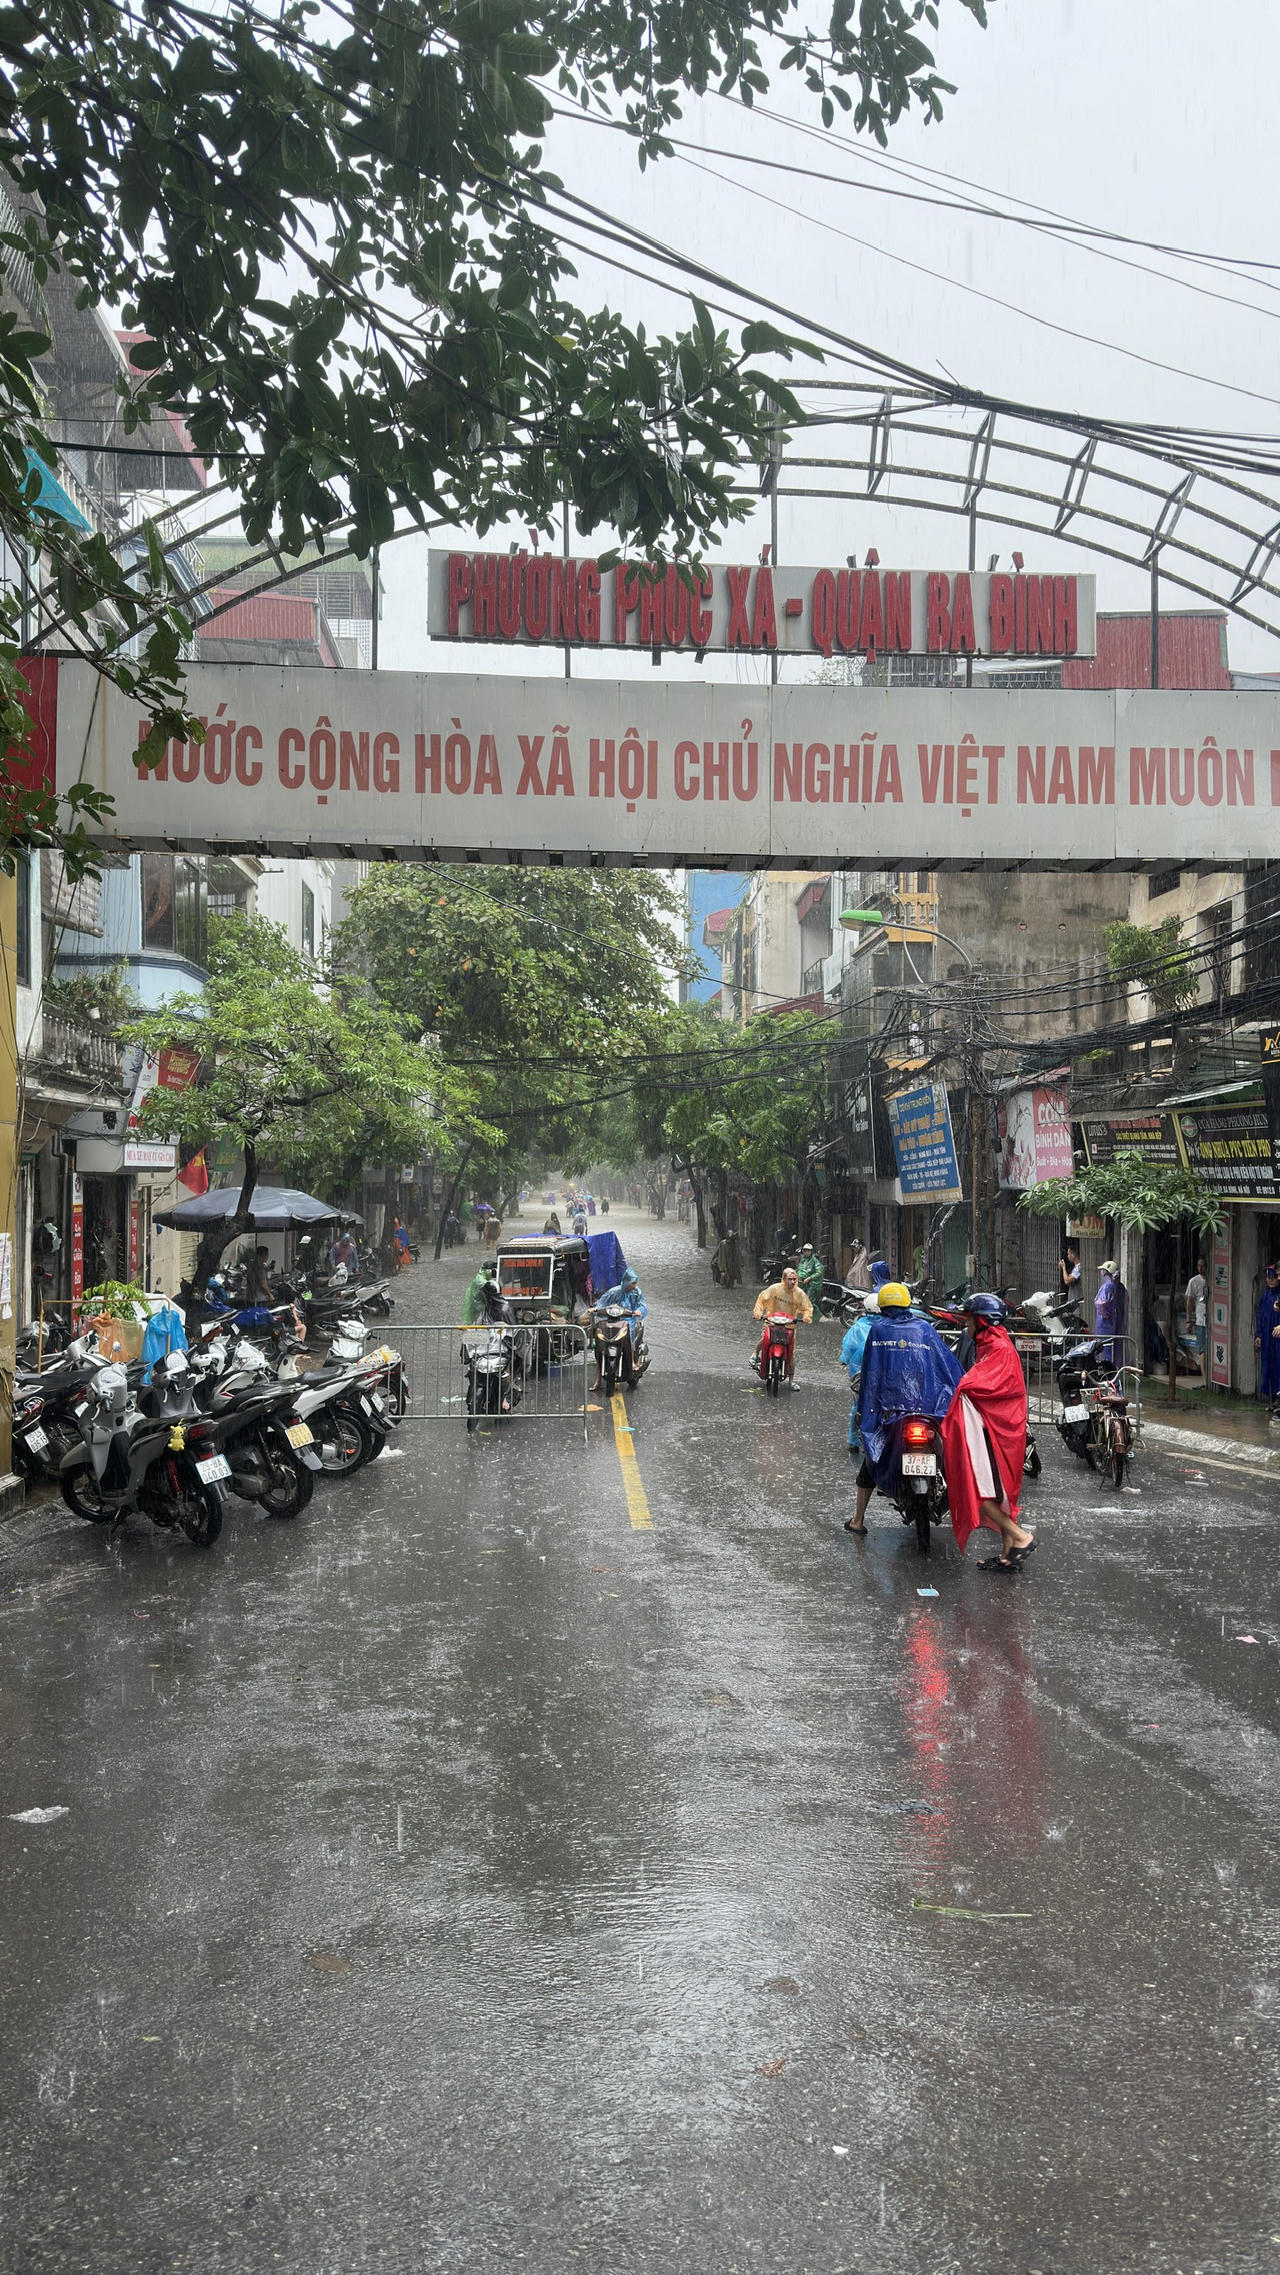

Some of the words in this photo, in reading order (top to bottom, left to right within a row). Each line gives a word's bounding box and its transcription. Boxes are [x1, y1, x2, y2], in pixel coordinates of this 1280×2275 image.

[448, 528, 601, 643] PHƯỜNG
[726, 544, 777, 649] XÁ
[812, 548, 912, 665] QUẬN
[927, 571, 977, 653] BA
[988, 552, 1078, 654] ĐÌNH
[278, 715, 400, 805] CỘNG
[415, 717, 503, 796] HÒA
[517, 725, 575, 798] XÃ
[588, 727, 658, 813] HỘI
[674, 718, 758, 802] CHỦ
[773, 731, 904, 805] NGHĨA
[917, 733, 1005, 818] VIỆT
[1016, 745, 1115, 805] NAM
[1129, 735, 1254, 807] MUÔN
[1036, 1130, 1052, 1148] BÌNH
[1054, 1129, 1071, 1147] DÂN
[1229, 1140, 1243, 1158] PVC
[202, 1466, 229, 1482] 040.03
